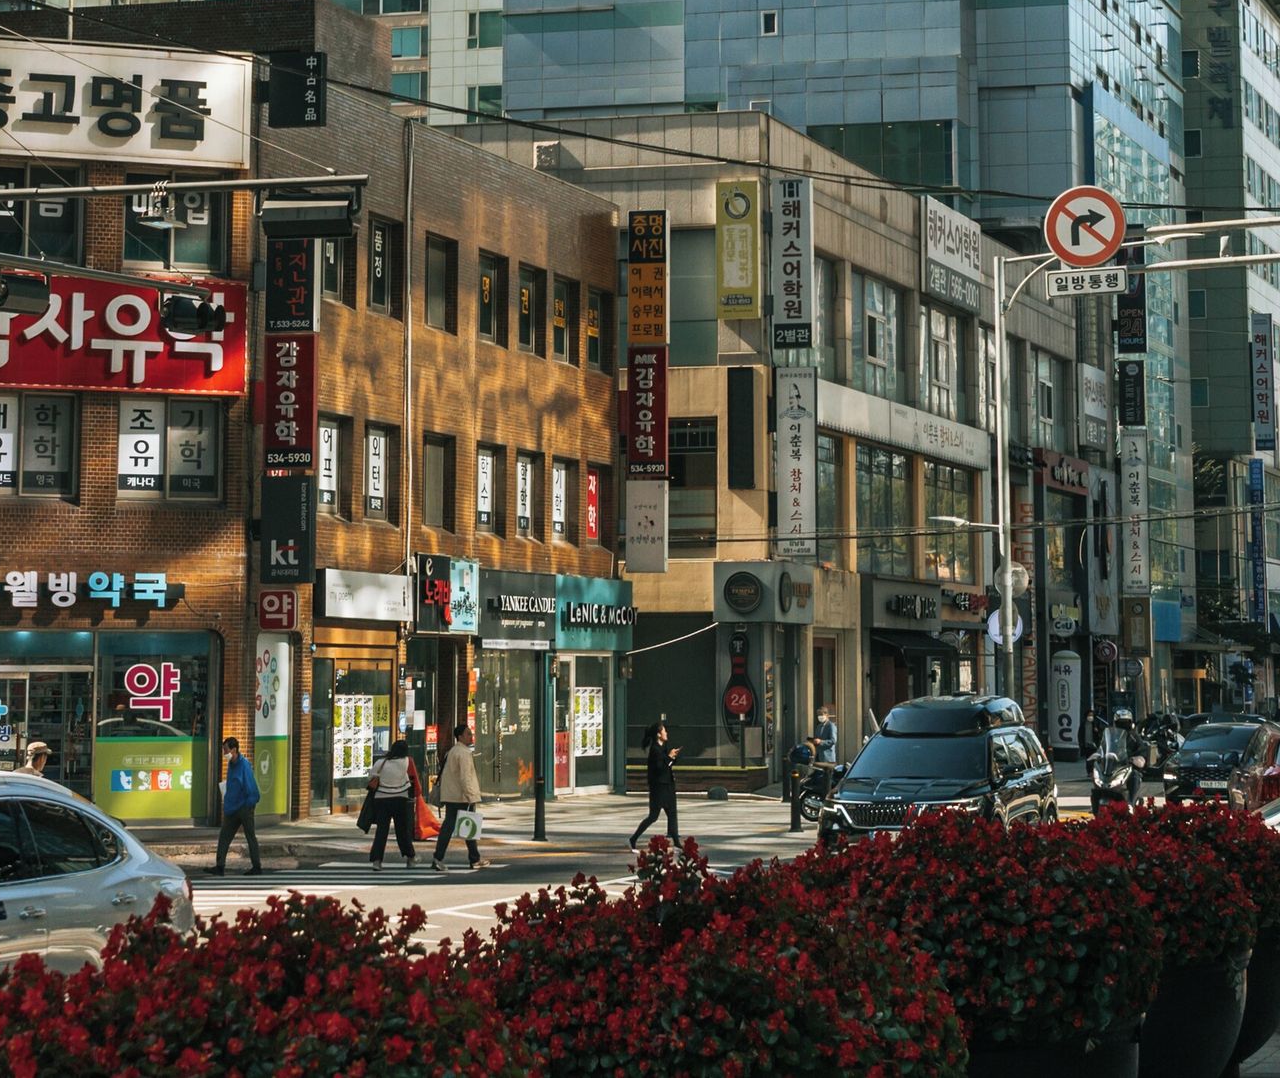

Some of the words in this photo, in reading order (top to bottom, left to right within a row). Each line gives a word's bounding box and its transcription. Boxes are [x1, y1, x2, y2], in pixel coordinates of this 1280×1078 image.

[632, 215, 663, 236] 증명
[632, 238, 663, 259] 사진
[928, 209, 980, 271] 해커스어학원
[780, 199, 803, 320] 해커스어학원
[930, 263, 946, 295] 2별관
[1054, 272, 1120, 292] 일방통행
[631, 285, 664, 299] 이력서
[631, 304, 664, 319] 승무원
[1120, 308, 1144, 318] OPEN
[269, 319, 310, 329] T.533-5242
[631, 324, 664, 337] 프로필
[1120, 318, 1144, 336] 24
[775, 328, 810, 345] 2별관
[1120, 337, 1145, 345] HOURS
[634, 354, 657, 365] MK
[1254, 333, 1270, 425] 해커스어학원
[275, 341, 300, 446] 감자유학
[634, 367, 656, 457] 감자유학
[789, 423, 803, 462] 이춘복
[267, 452, 311, 464] 534-5930
[630, 463, 665, 474] 534-5930
[35, 473, 56, 487] 영국
[126, 475, 155, 489] 캐나다
[182, 477, 202, 489] 미국
[1128, 471, 1141, 507] 이춘복
[300, 506, 308, 531] telecom
[270, 539, 300, 566] kt
[4, 569, 168, 608] 웰빙약국
[424, 578, 451, 605] 노래바
[262, 593, 293, 627] 약
[500, 594, 529, 612] YANKEE
[529, 595, 556, 614] CANDLE
[570, 601, 598, 623] LeNIC
[600, 604, 607, 623] &
[608, 605, 639, 626] McCOY
[124, 661, 181, 722] 약
[730, 693, 747, 708] 24
[1057, 713, 1073, 742] CU
